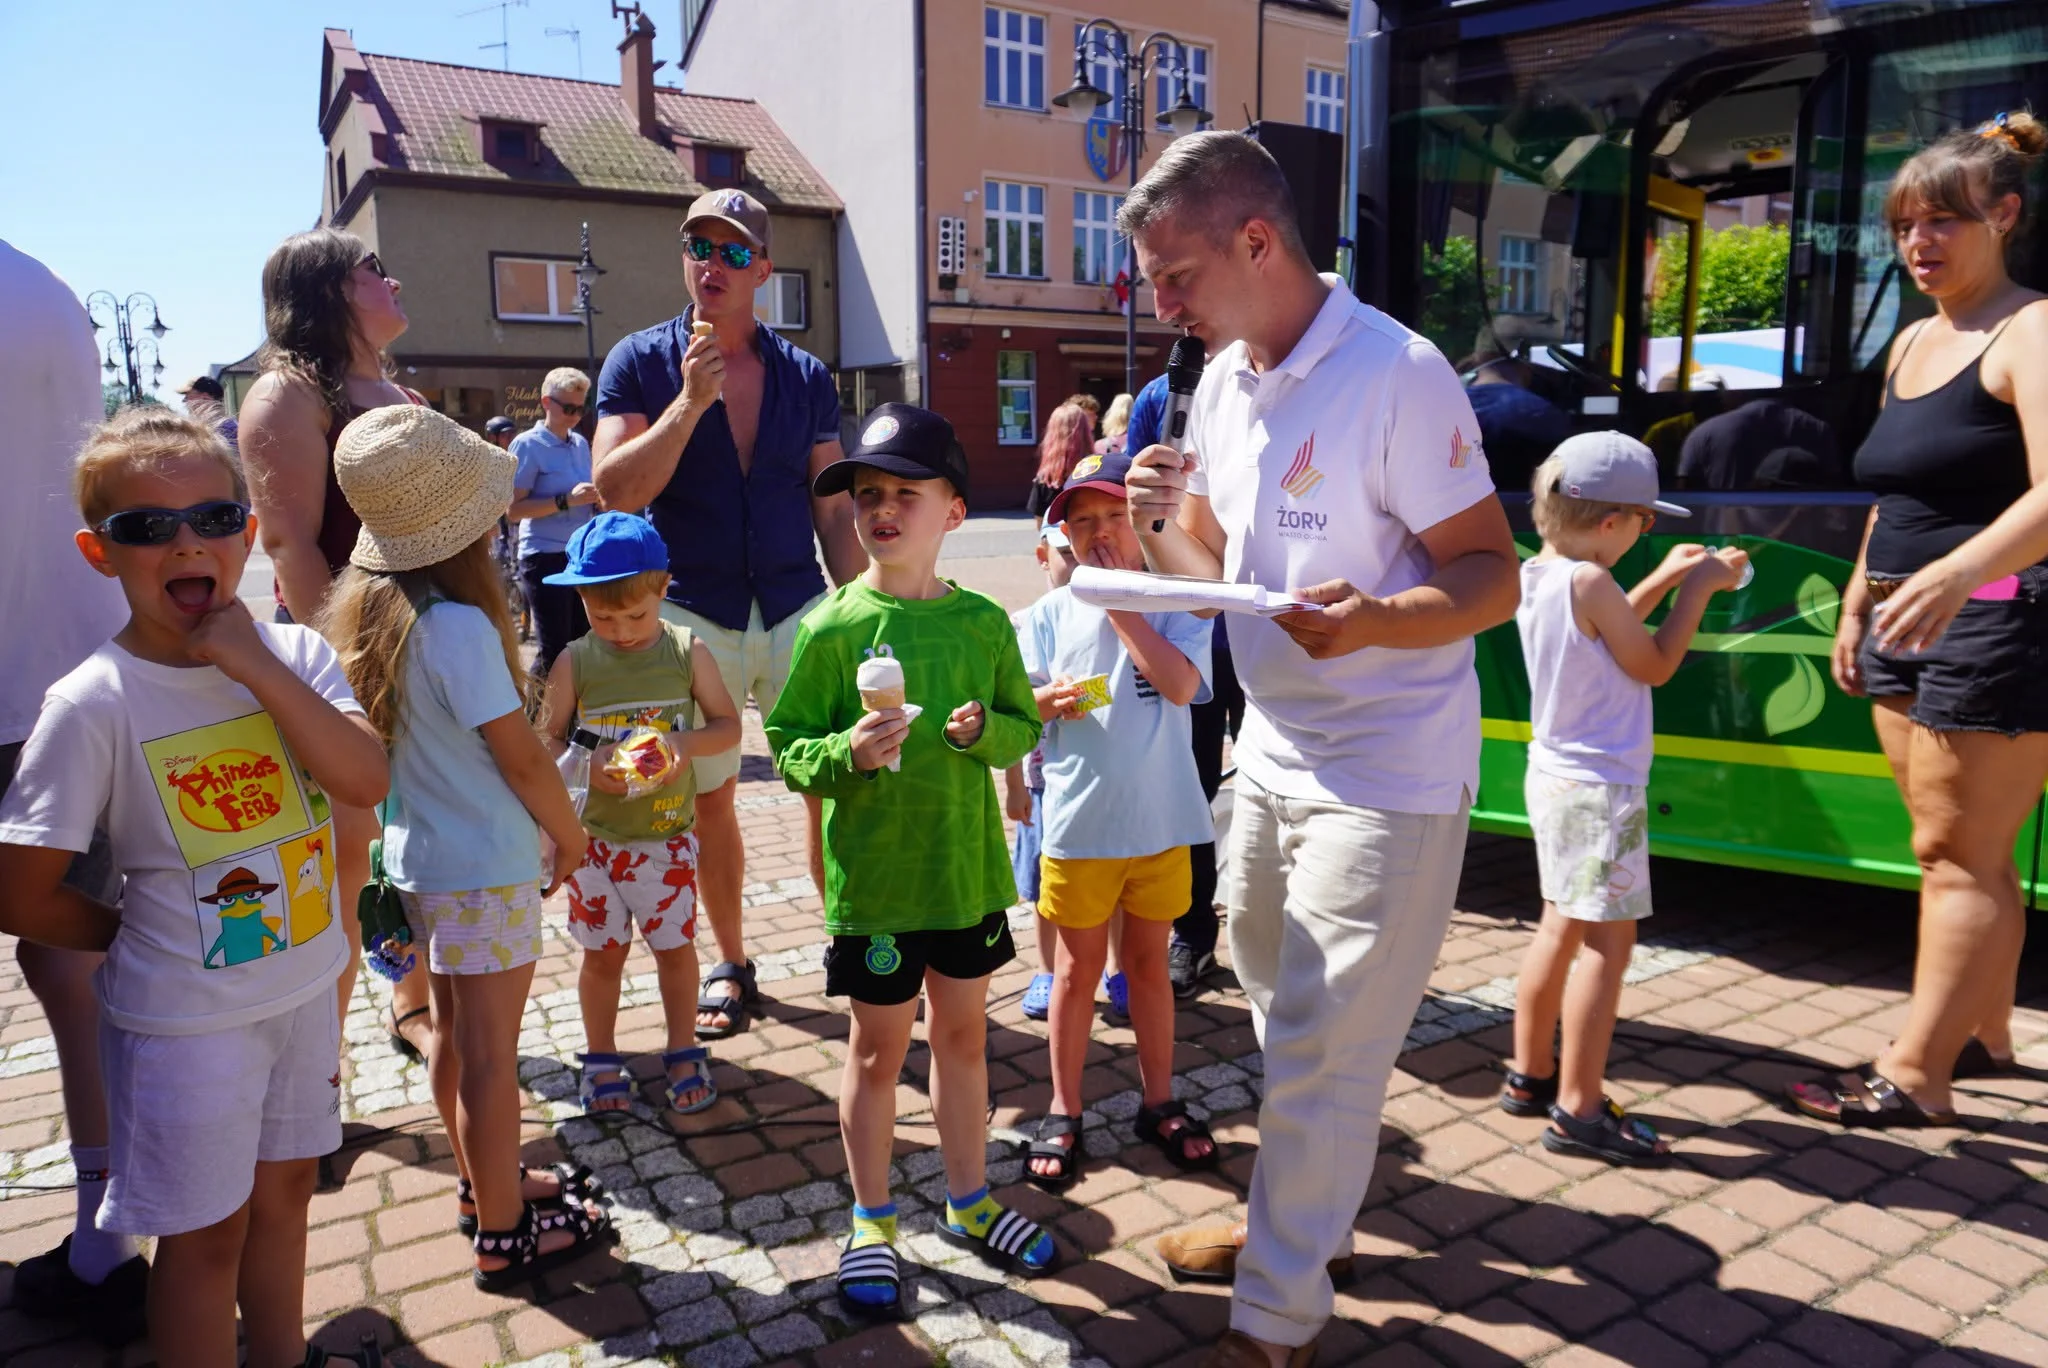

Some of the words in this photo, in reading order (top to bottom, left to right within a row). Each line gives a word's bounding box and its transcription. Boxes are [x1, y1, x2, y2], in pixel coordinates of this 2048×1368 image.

[713, 187, 743, 216] NY
[1277, 505, 1327, 531] ŻORY
[167, 755, 281, 808] Phineas
[664, 810, 677, 821] TO
